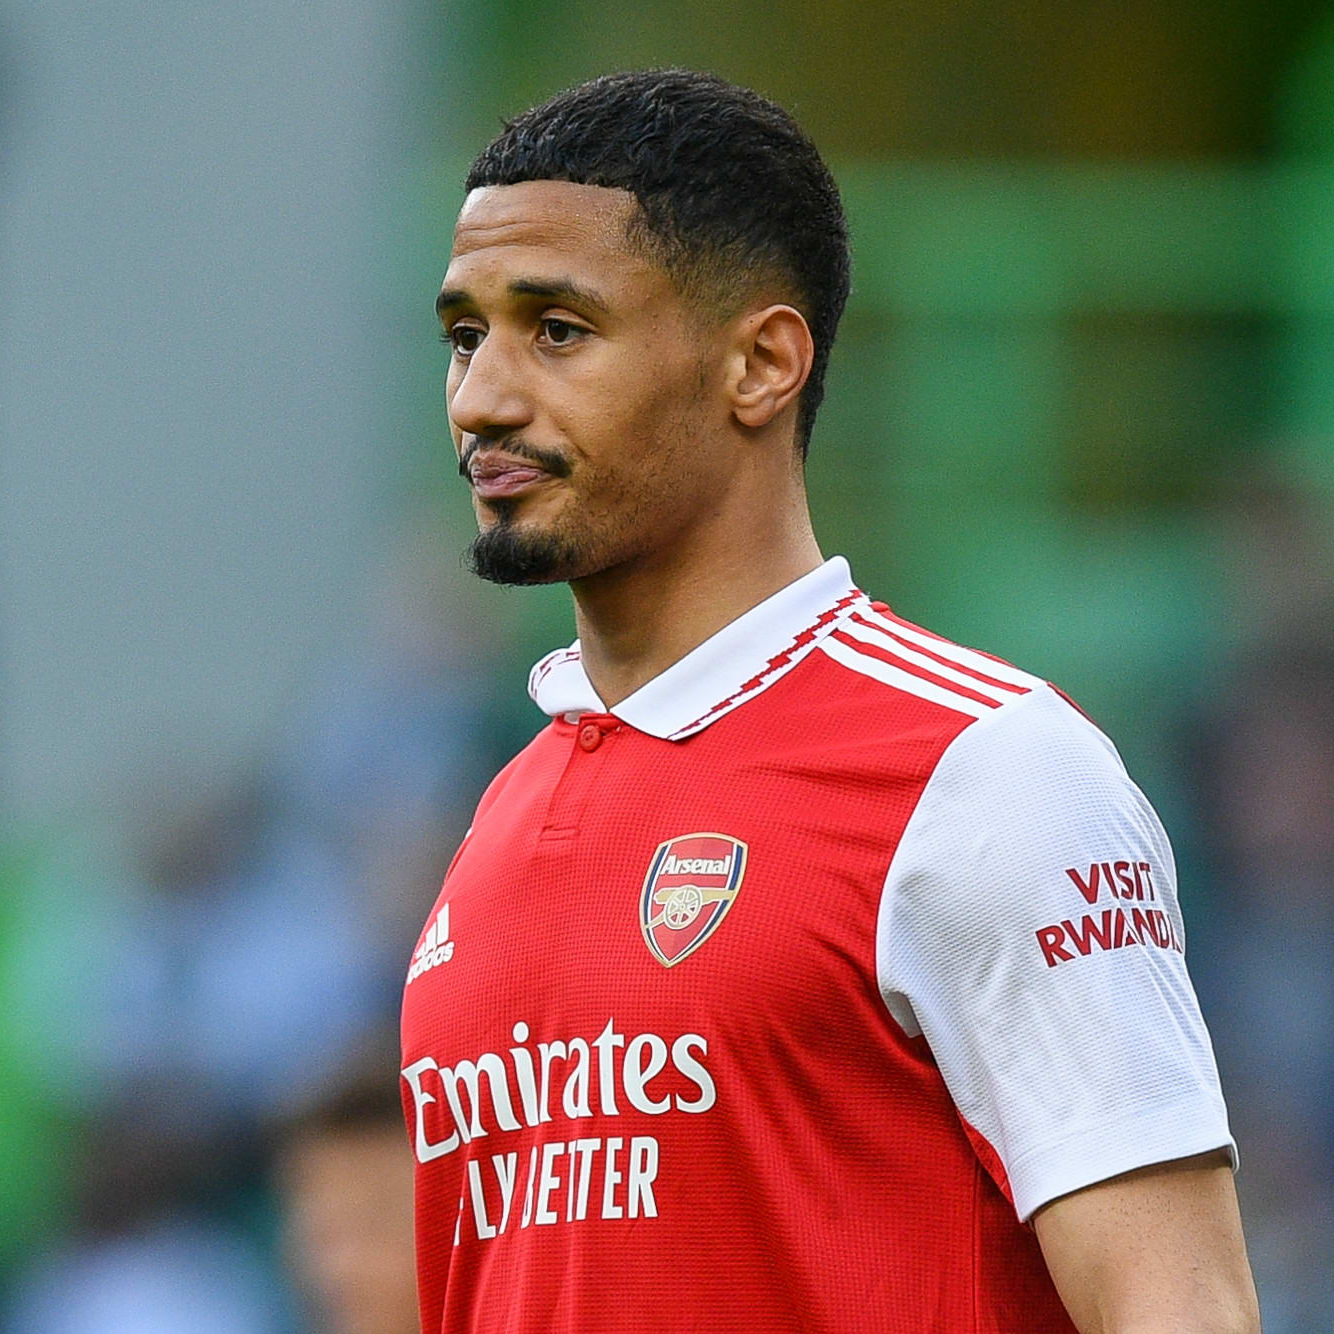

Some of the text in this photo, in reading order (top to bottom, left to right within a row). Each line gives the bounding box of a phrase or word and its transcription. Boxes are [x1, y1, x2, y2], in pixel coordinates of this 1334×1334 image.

[660, 855, 731, 875] Arsenal
[1064, 861, 1155, 904] VISIT
[1035, 907, 1183, 968] RWAND
[401, 1017, 716, 1164] Emirates
[449, 1152, 517, 1246] LY
